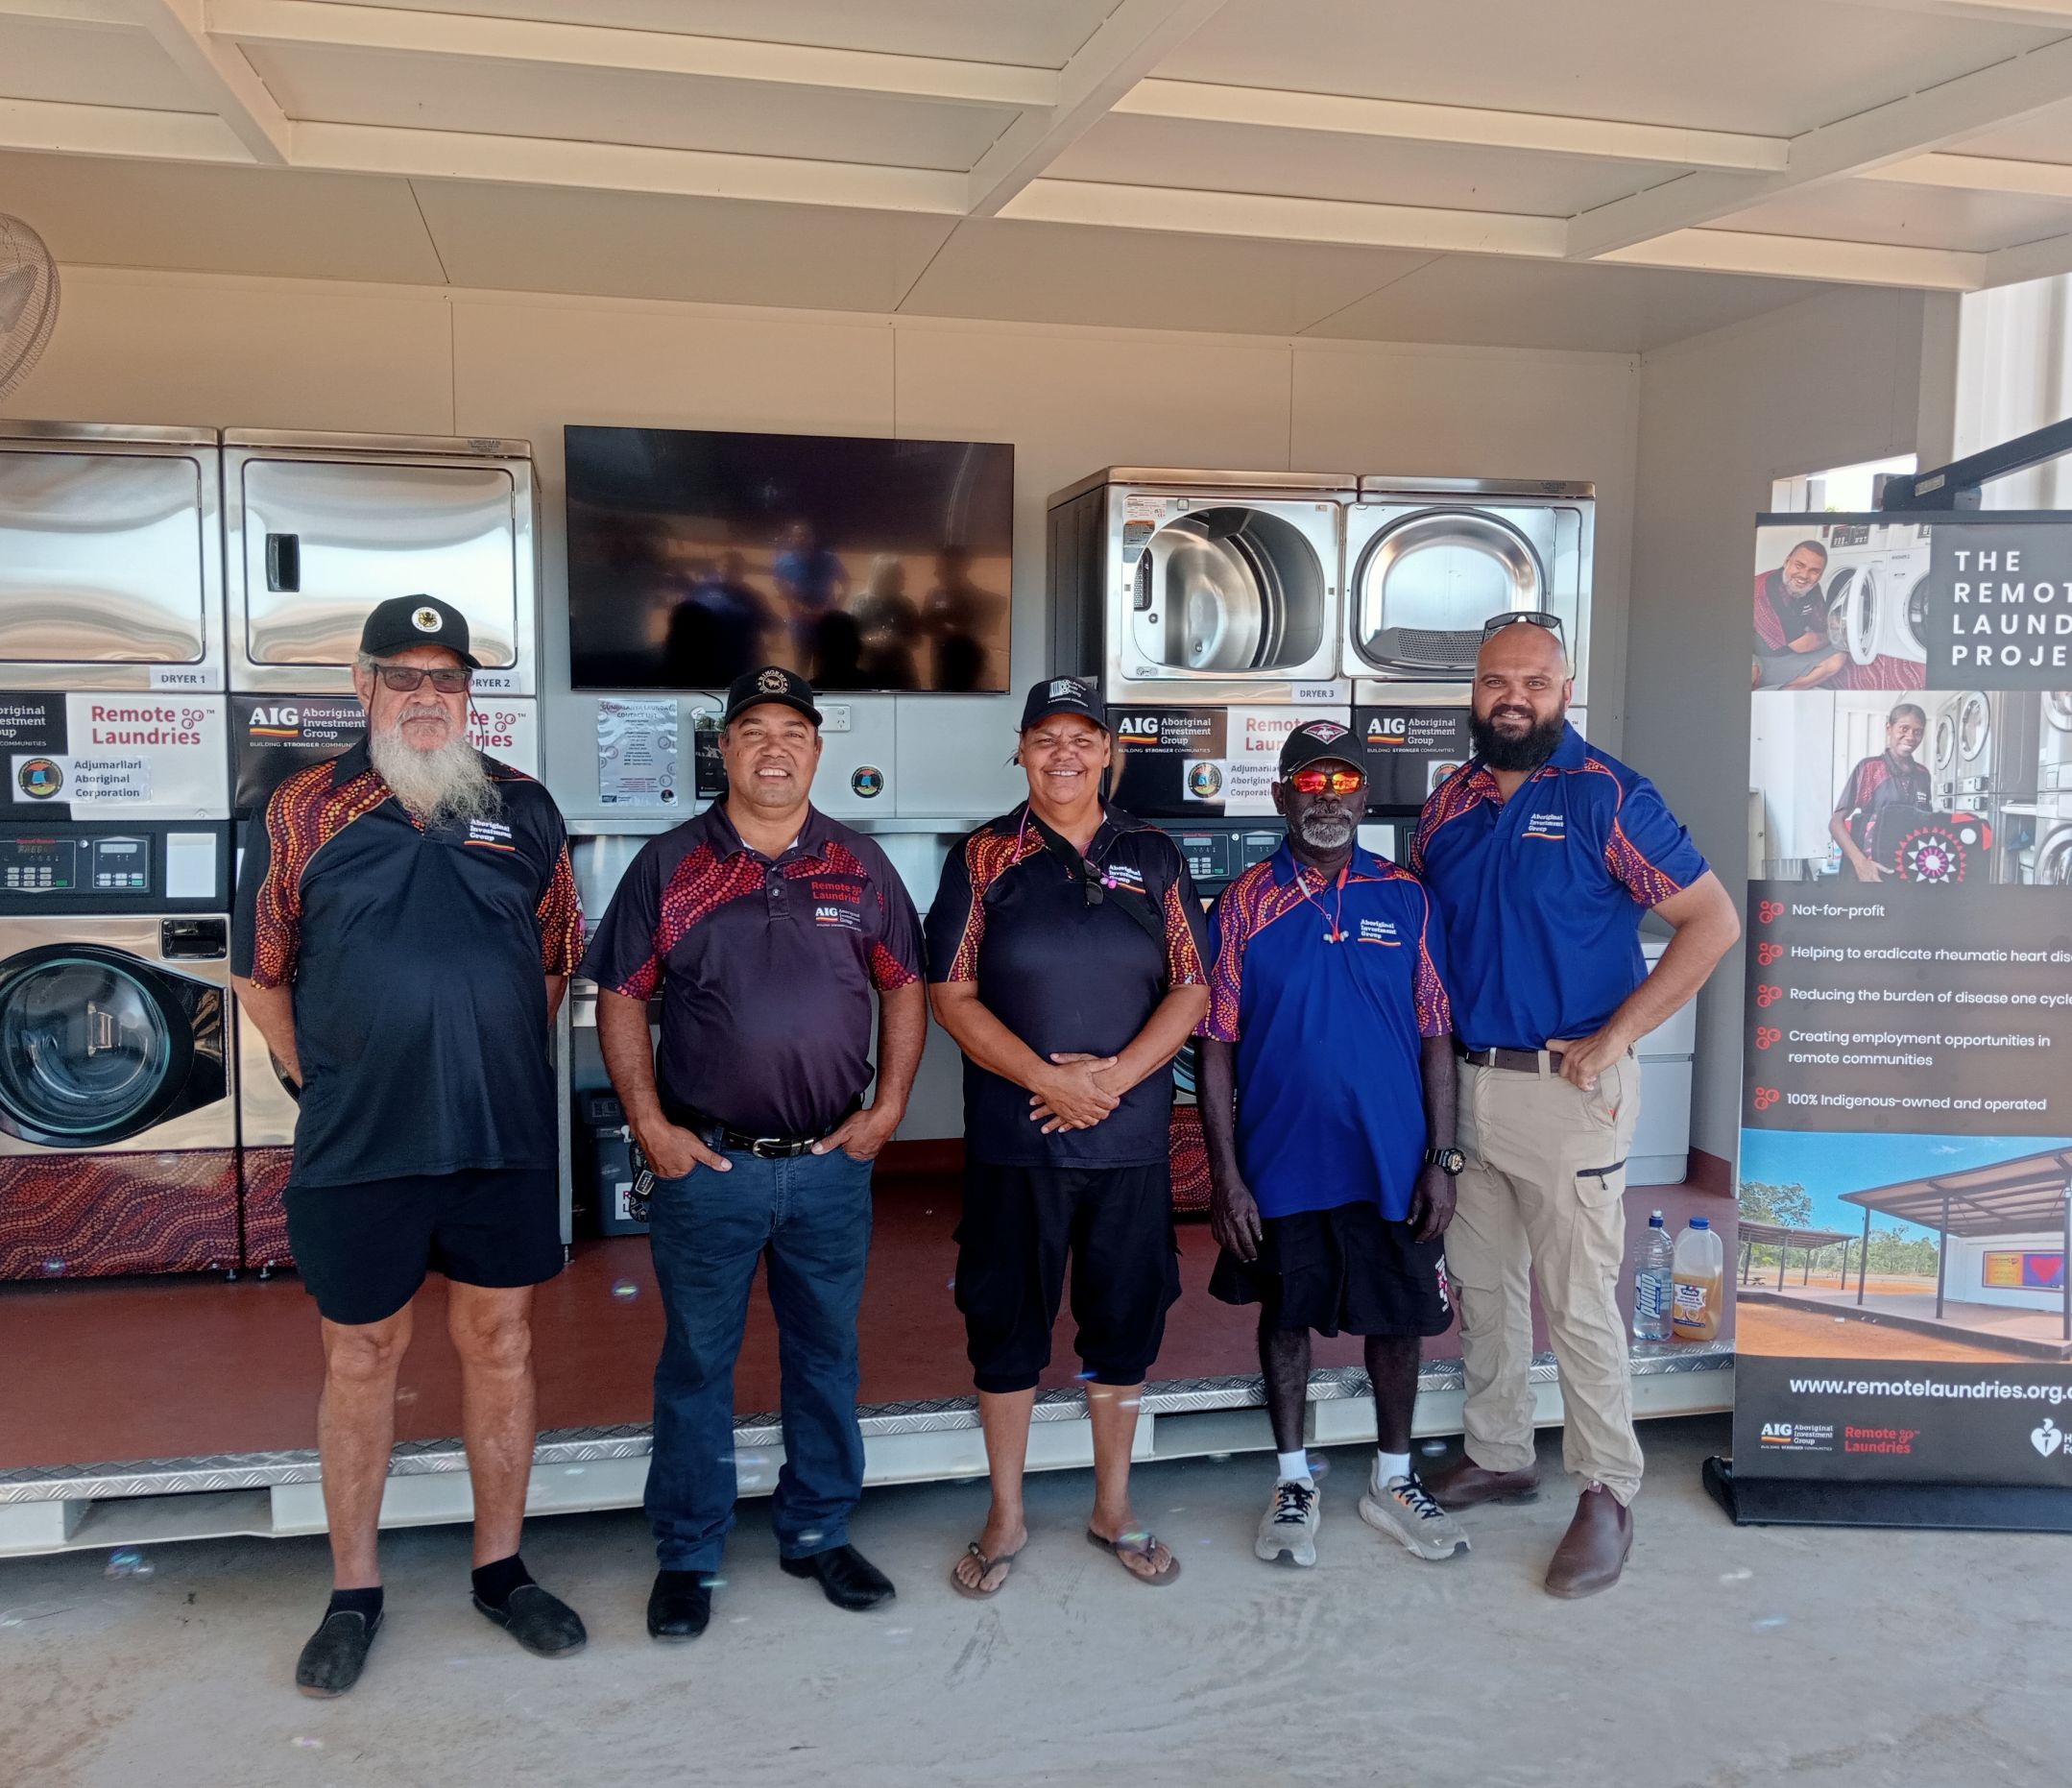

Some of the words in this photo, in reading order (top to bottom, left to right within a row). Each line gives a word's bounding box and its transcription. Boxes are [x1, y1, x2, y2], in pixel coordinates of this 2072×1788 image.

[1954, 551, 2020, 571] THE
[1953, 582, 2072, 603] REMOT
[1953, 614, 2072, 635] LAUND
[1952, 645, 2067, 666] PROJE
[160, 674, 197, 684] DRYER
[200, 675, 205, 684] 1
[504, 679, 511, 688] 2
[1299, 689, 1327, 698] DRYER
[1328, 689, 1335, 698] 3
[91, 706, 176, 722] Remote
[249, 707, 299, 726] AIG
[302, 708, 366, 718] Aboriginal
[302, 718, 366, 728] Investment
[1118, 717, 1158, 735] AIG
[1161, 717, 1211, 728] Aboriginal
[1246, 717, 1307, 732] Remot
[1367, 717, 1406, 735] AIG
[1408, 718, 1456, 728] Aboriginal
[92, 728, 201, 745] Laundries
[302, 729, 338, 739] Group
[1161, 727, 1211, 736] Investment
[1408, 727, 1456, 736] Investment
[1161, 737, 1189, 745] Group
[1408, 737, 1434, 746] Group
[75, 774, 130, 785] Aboriginal
[76, 788, 140, 799] Corporation
[470, 832, 494, 841] Group
[811, 882, 851, 892] Remote
[812, 891, 860, 904] Laundries
[815, 906, 838, 917] AIG
[1792, 904, 1886, 920] Not-for-profit
[1791, 946, 1843, 961] Helping
[1846, 947, 1861, 959] to
[1864, 947, 1931, 960] eradicate
[1935, 949, 2008, 961] rheumatic
[2011, 950, 2047, 962] heart
[2050, 951, 2072, 962] dis
[1790, 988, 1854, 1004] Reducing
[1858, 989, 1880, 1001] the
[1884, 989, 1934, 1003] burden
[1938, 991, 1952, 1003] of
[1955, 991, 2008, 1004] disease
[2011, 995, 2036, 1004] one
[1789, 1029, 1849, 1046] Creating
[1852, 1031, 1941, 1047] employment
[1944, 1033, 2035, 1049] opportunities
[2037, 1034, 2051, 1047] in
[1788, 1051, 1840, 1064] remote
[1842, 1052, 1934, 1066] communities
[1787, 1093, 1819, 1105] 100%
[1820, 1094, 1950, 1109] Indigenous-owned
[1953, 1098, 1982, 1110] and
[1984, 1099, 2047, 1112] operated
[1760, 1422, 1793, 1436] AIG
[1844, 1426, 1896, 1439] Remote
[1844, 1440, 1911, 1454] Laundries
